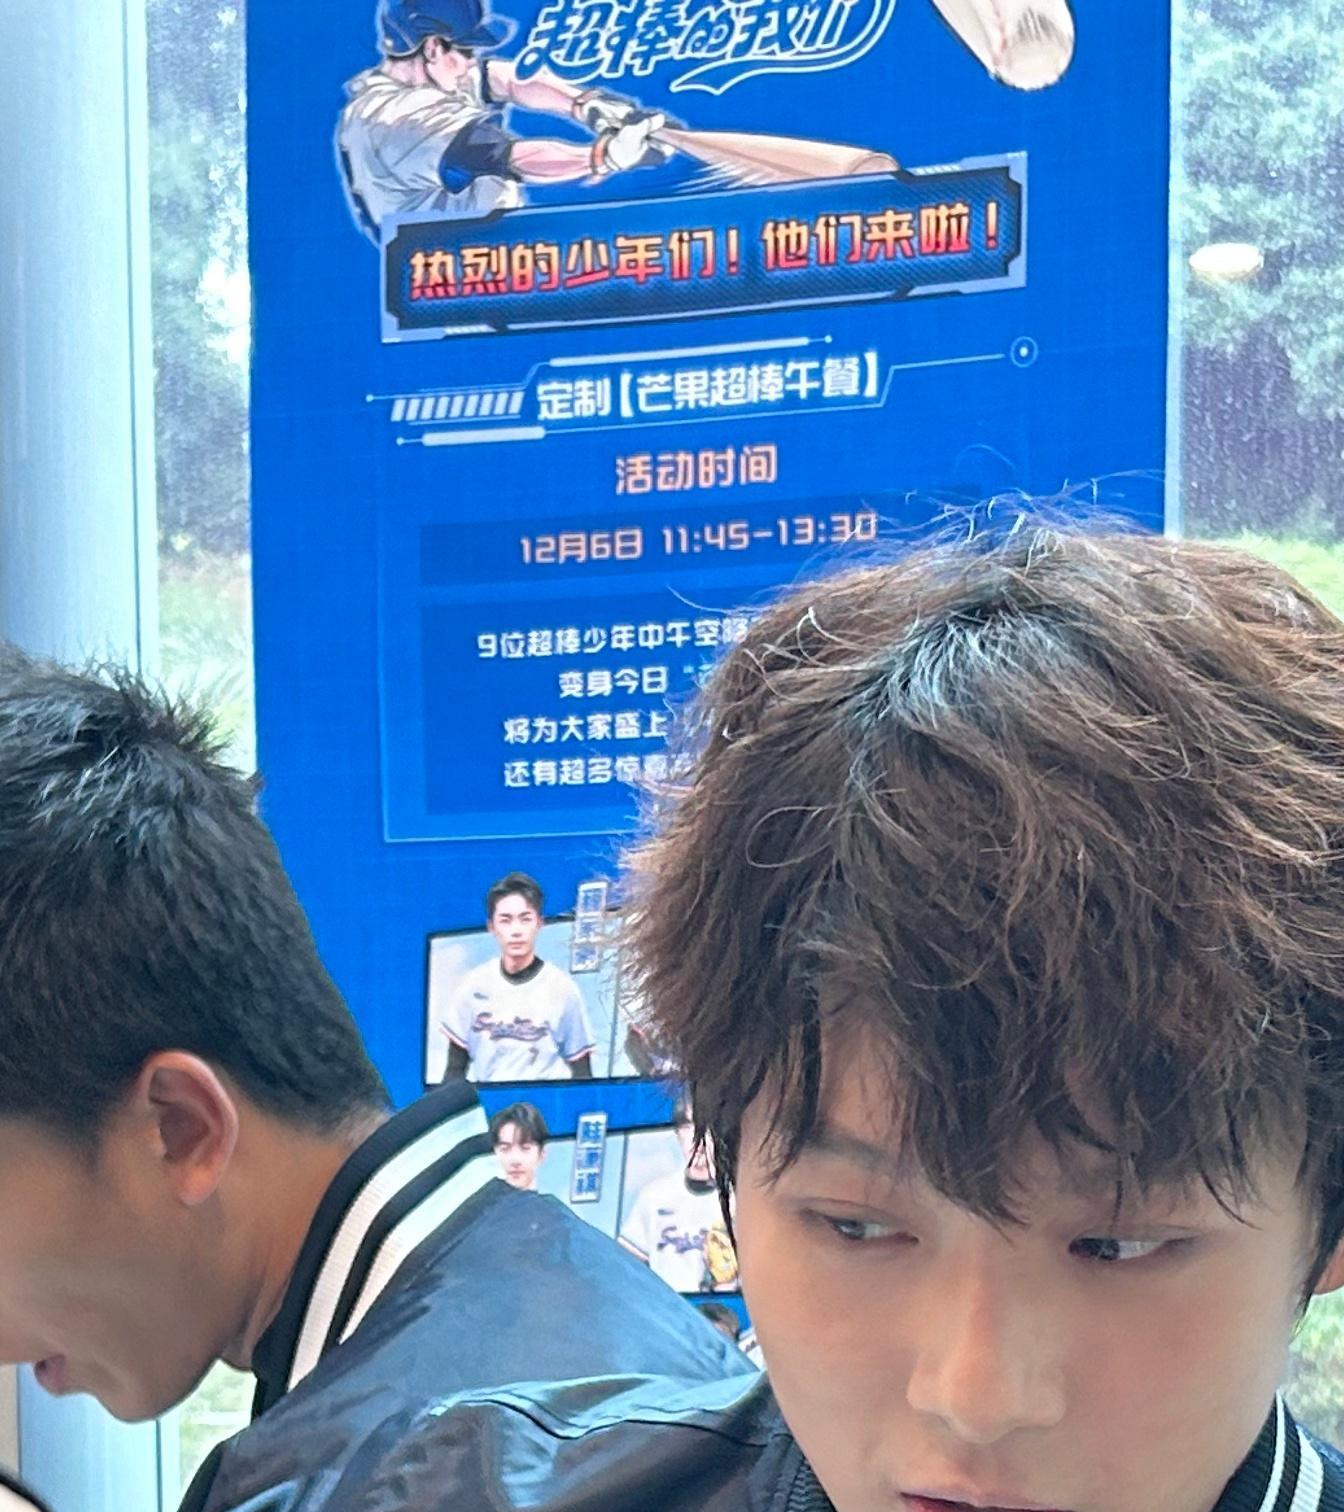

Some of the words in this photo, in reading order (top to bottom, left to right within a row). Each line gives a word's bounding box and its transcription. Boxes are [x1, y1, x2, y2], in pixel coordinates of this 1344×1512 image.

[537, 352, 879, 421] 定制【芒果超棒午餐】
[615, 444, 778, 495] 活动时间
[521, 528, 644, 565] 12月6日
[662, 511, 877, 556] 11:45-13:30
